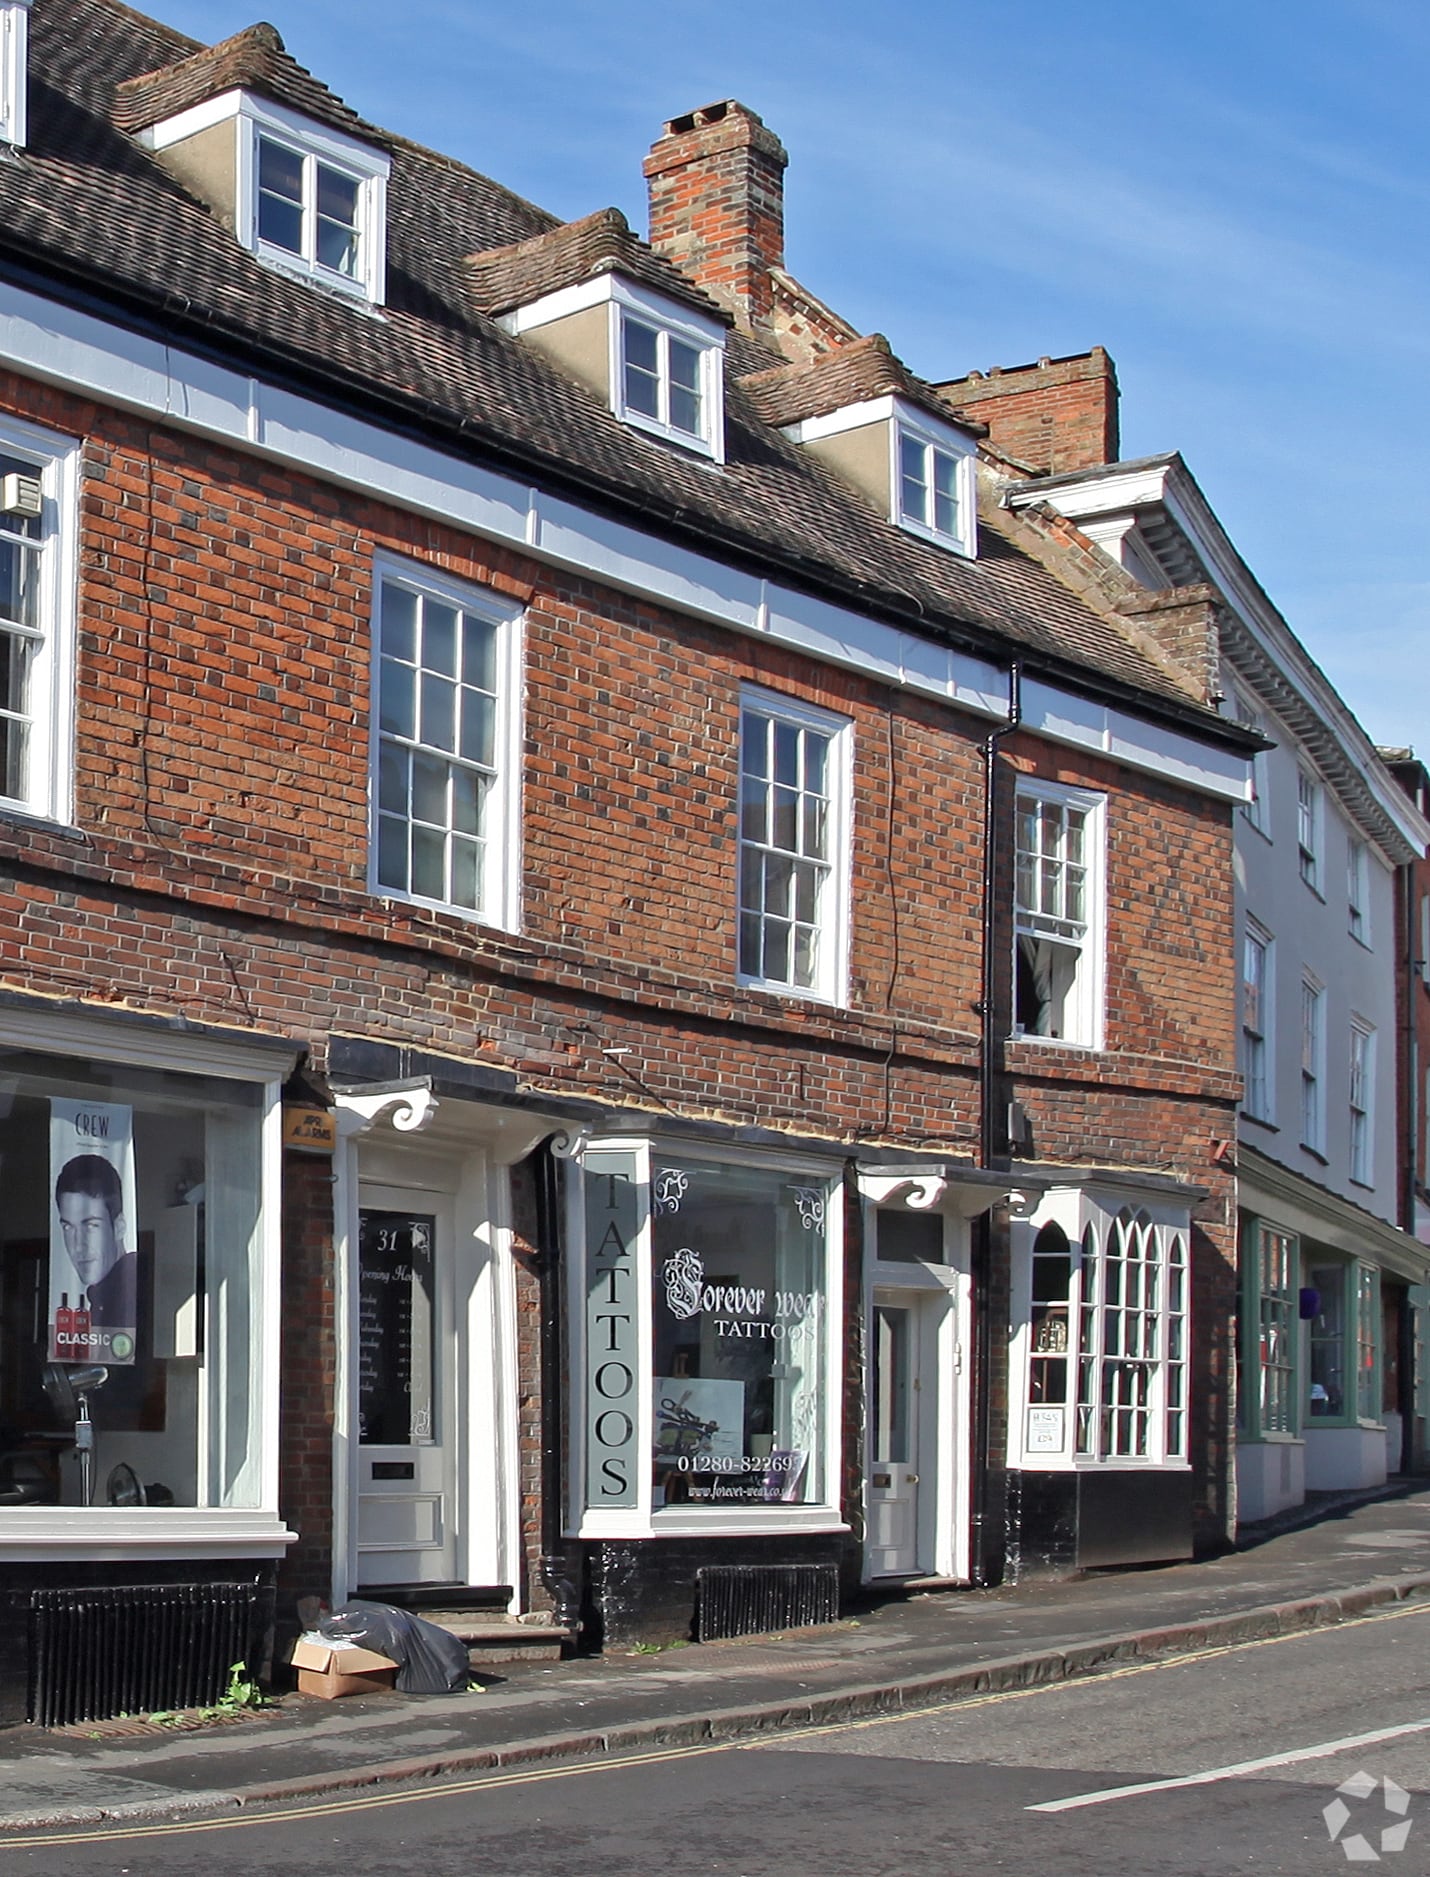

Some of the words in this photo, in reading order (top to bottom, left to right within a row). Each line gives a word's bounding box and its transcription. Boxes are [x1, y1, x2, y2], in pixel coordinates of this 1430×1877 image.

[75, 1112, 110, 1137] CREW
[377, 1229, 398, 1251] 31
[57, 1332, 111, 1346] CLASSIC
[594, 1173, 634, 1496] TATTOOS
[713, 1319, 816, 1341] TATTOOS
